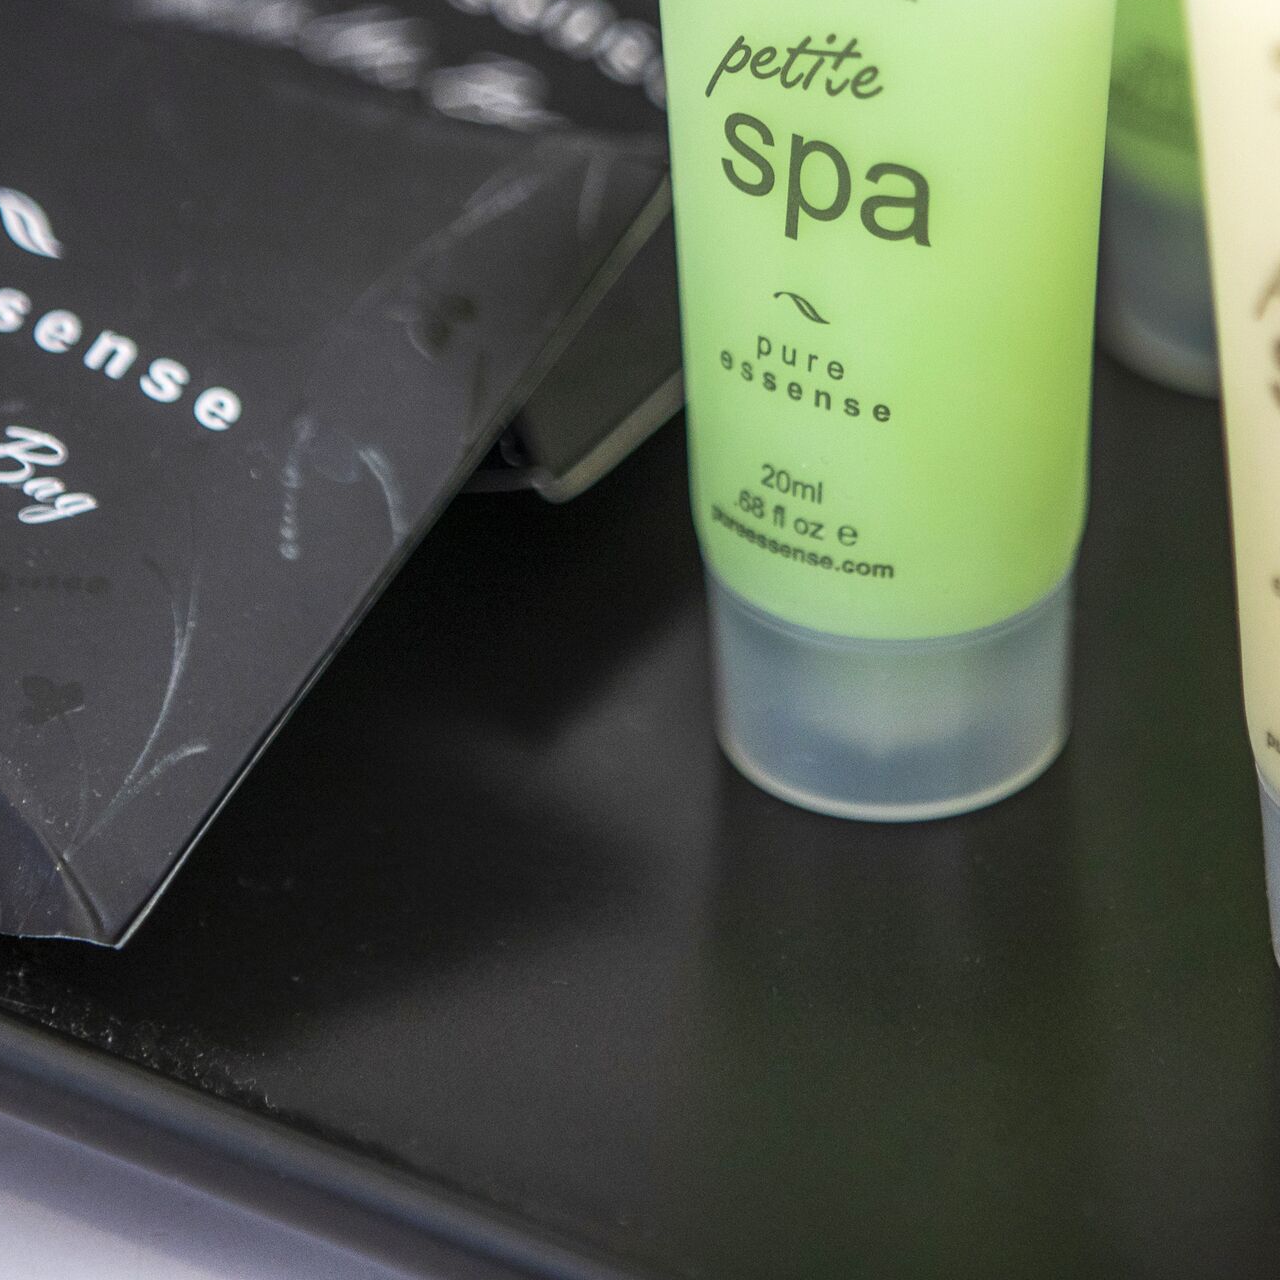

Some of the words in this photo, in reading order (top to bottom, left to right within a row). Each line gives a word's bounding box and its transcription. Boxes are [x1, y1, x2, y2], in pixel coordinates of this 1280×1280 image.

[704, 32, 885, 100] petite
[720, 110, 933, 248] spa
[719, 349, 892, 423] essense
[756, 334, 845, 381] pure
[760, 463, 824, 506] 20ml
[793, 517, 825, 541] oz
